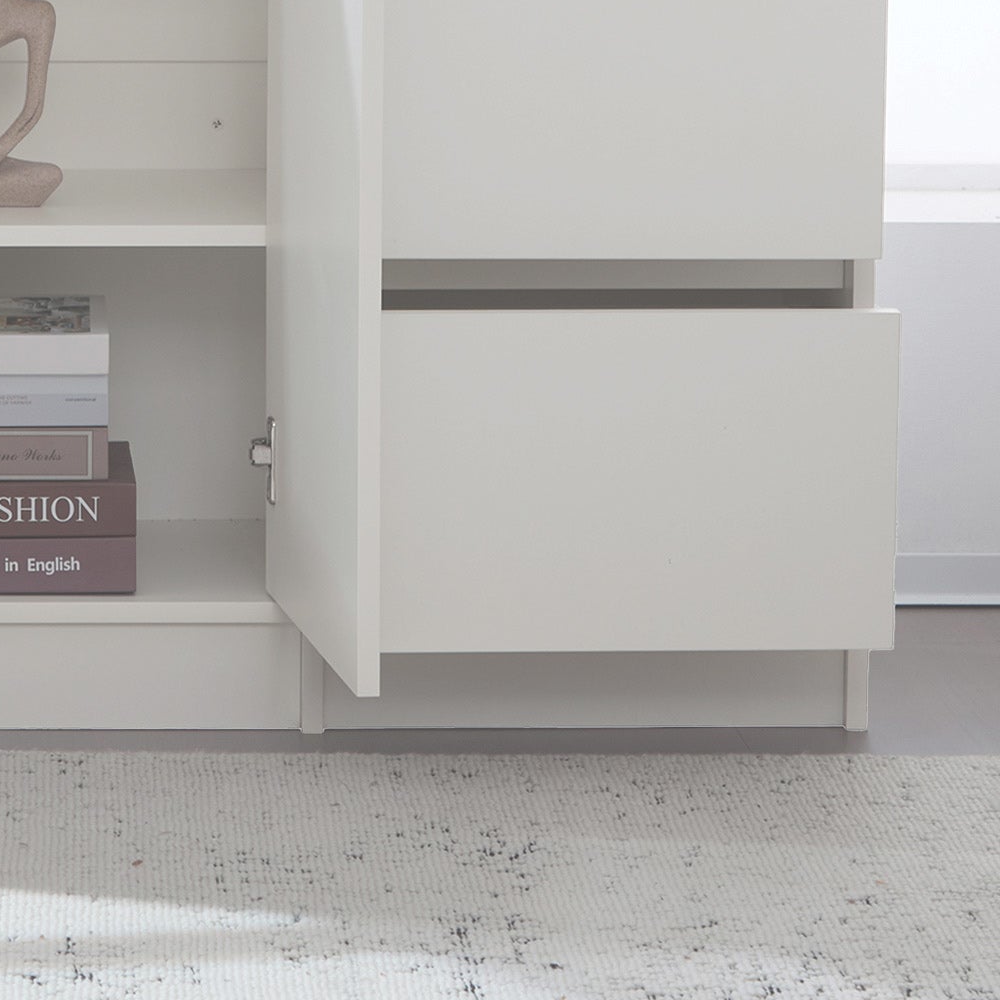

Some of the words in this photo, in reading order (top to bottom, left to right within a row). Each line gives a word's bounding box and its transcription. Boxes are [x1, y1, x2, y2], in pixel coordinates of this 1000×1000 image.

[23, 448, 63, 462] Works
[4, 557, 19, 571] in
[27, 556, 81, 575] English
